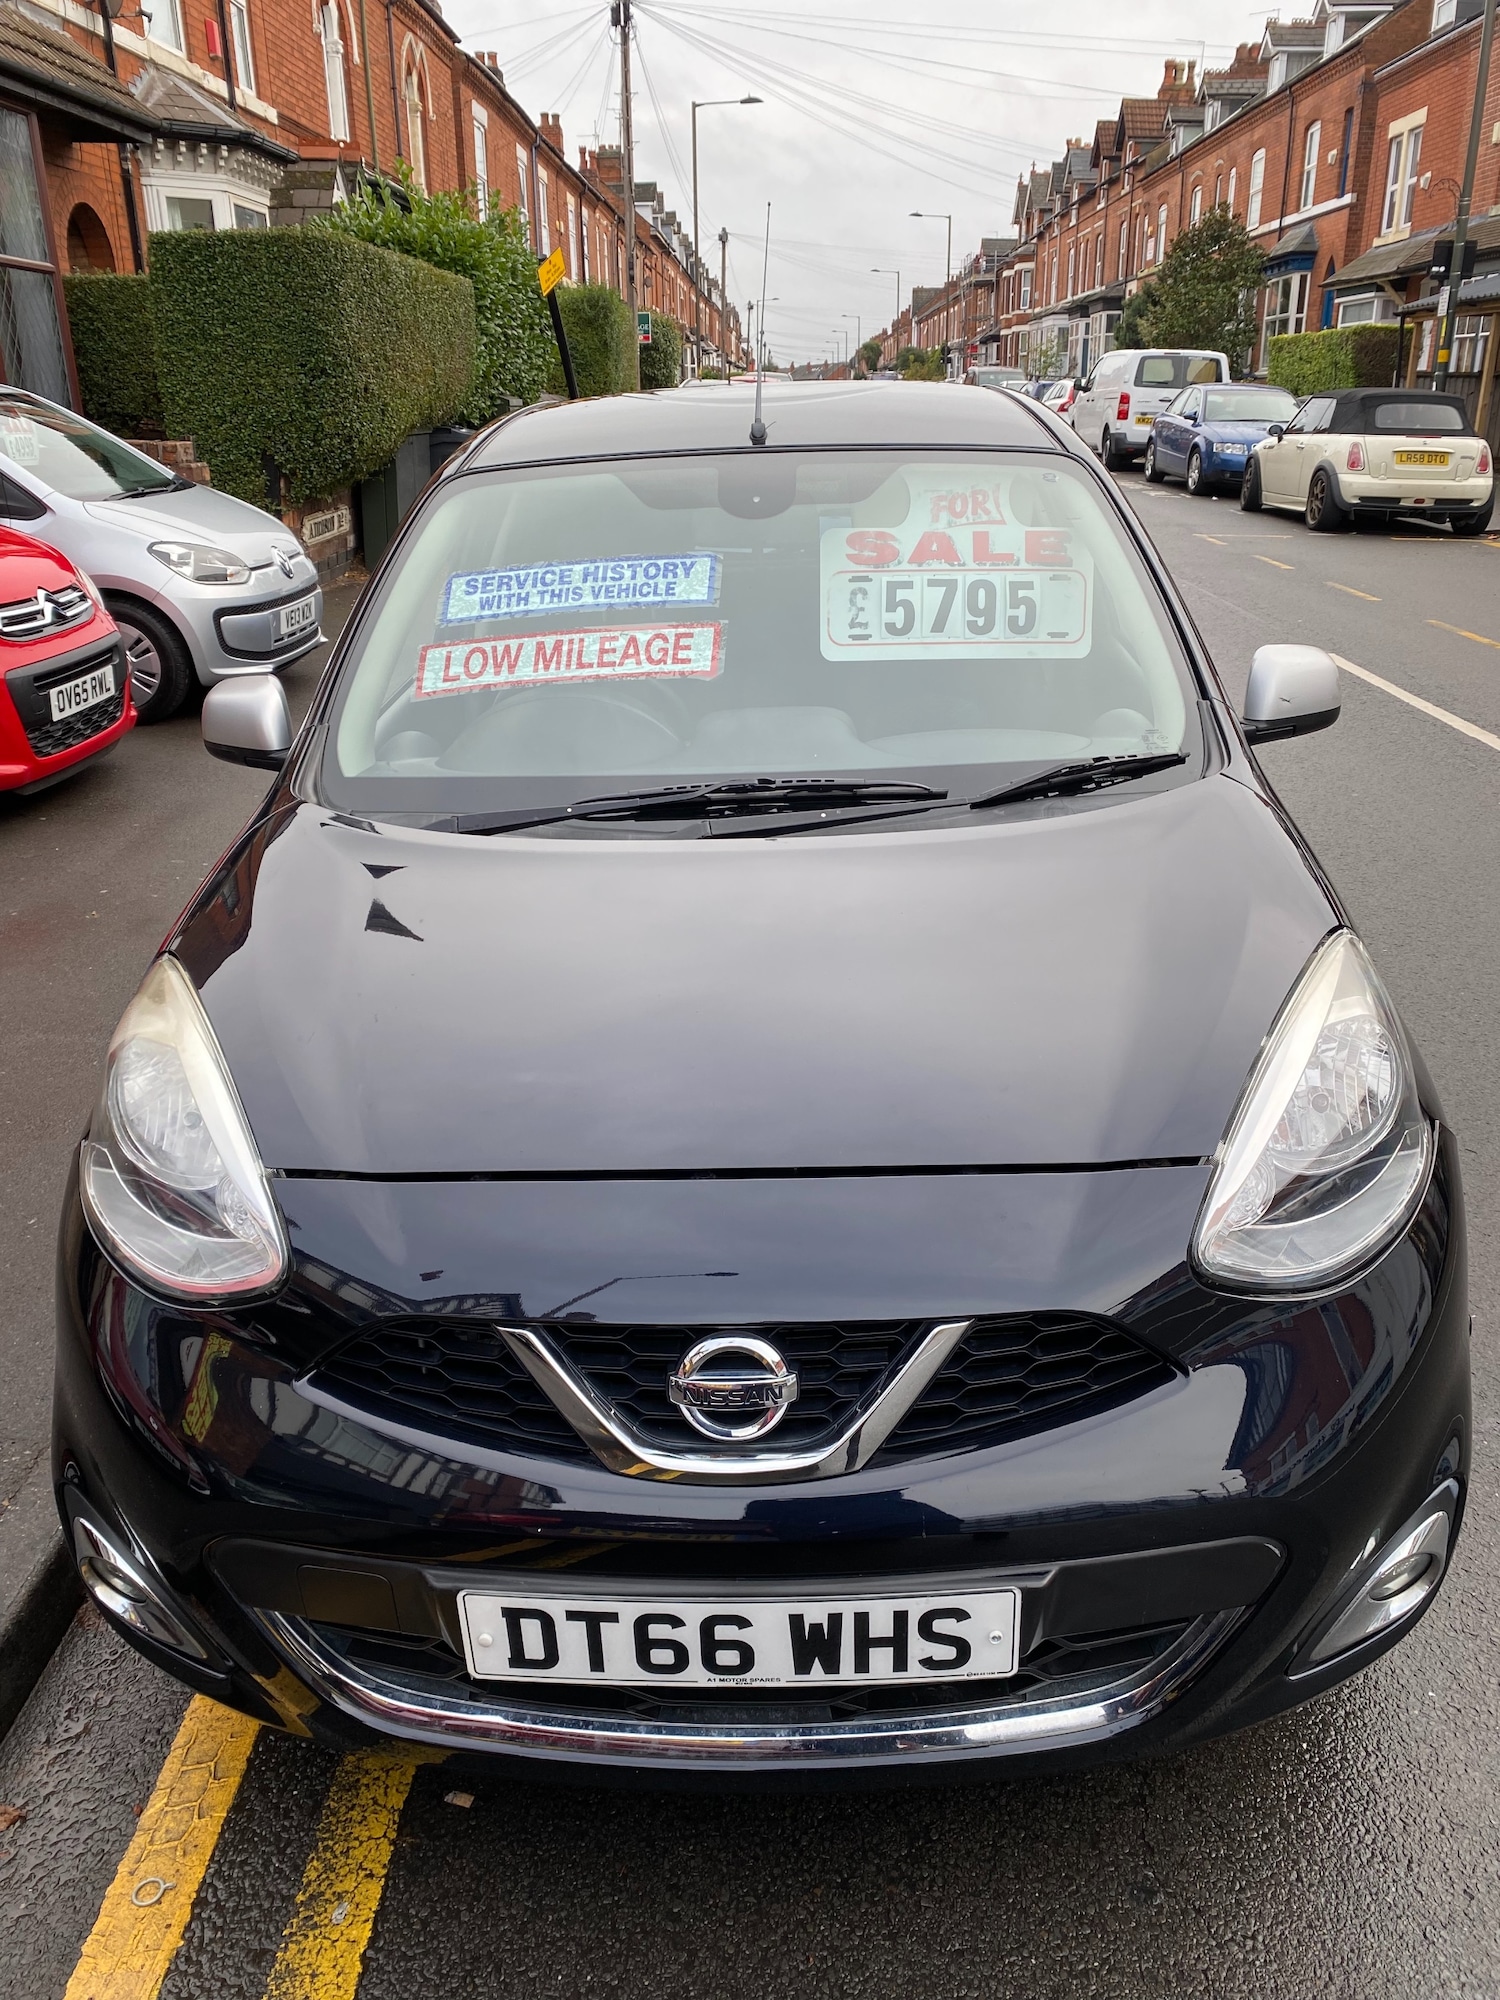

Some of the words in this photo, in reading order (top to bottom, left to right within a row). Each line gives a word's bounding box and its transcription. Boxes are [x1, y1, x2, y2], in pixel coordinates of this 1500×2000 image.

[1400, 453, 1425, 463] LR58
[929, 487, 991, 524] FOR
[845, 530, 1073, 567] SALE
[464, 567, 573, 596] SERVICE
[581, 559, 698, 585] HISTORY
[479, 591, 530, 611] WITH
[536, 586, 584, 604] THIS
[591, 581, 677, 599] VEHICLE
[848, 578, 1037, 637] £5795
[442, 643, 524, 684] LOW
[532, 631, 695, 674] MILEAGE
[56, 680, 89, 713] OV65
[90, 671, 111, 699] RWL
[682, 1383, 784, 1407] NISSAN
[500, 1606, 756, 1676] DT66
[788, 1606, 973, 1676] WHS
